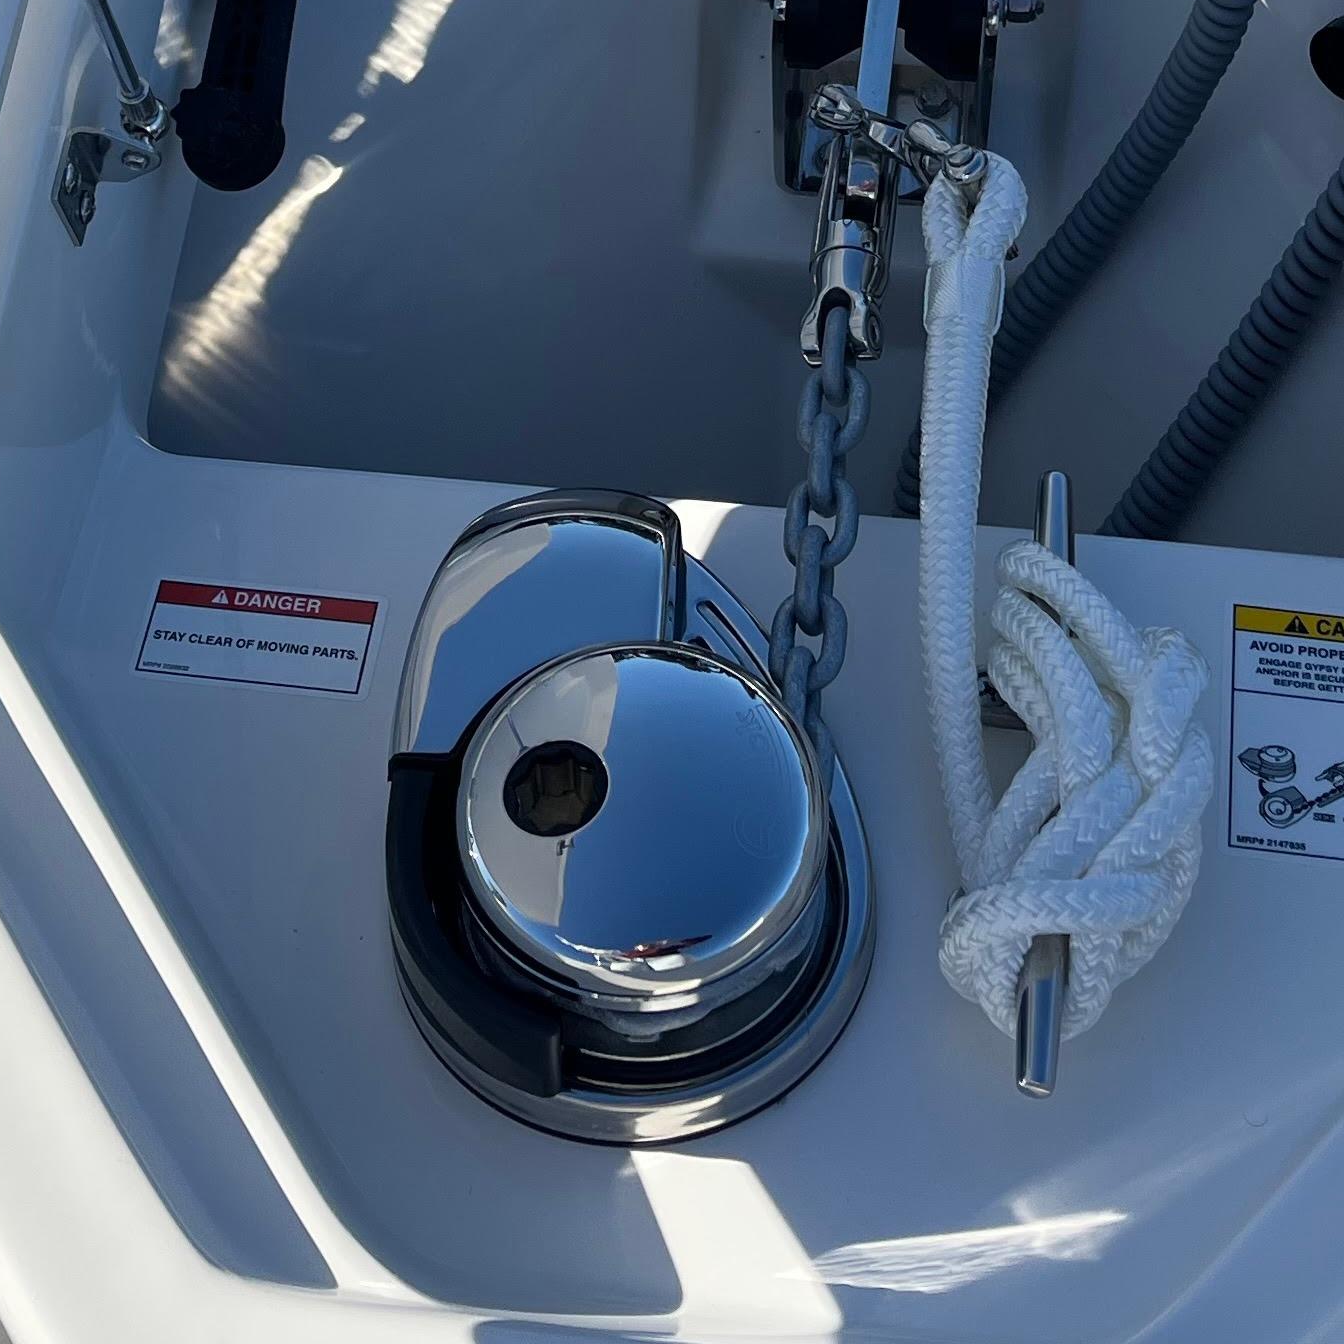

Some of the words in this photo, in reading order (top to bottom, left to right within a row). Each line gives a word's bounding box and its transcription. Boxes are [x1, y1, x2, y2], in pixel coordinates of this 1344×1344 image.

[233, 591, 321, 613] DANGER
[152, 629, 186, 642] STAY
[187, 633, 233, 647] CLEAR
[234, 638, 255, 649] OF
[256, 640, 309, 655] MOVING
[311, 646, 359, 660] PARTS.
[1249, 640, 1293, 655] AVOID
[1255, 666, 1298, 678] ANCHOR
[1258, 657, 1301, 669] ENGAGE
[1304, 662, 1338, 673] GYPSY
[1273, 678, 1314, 690] BEFORE
[1313, 812, 1334, 823] SEE
